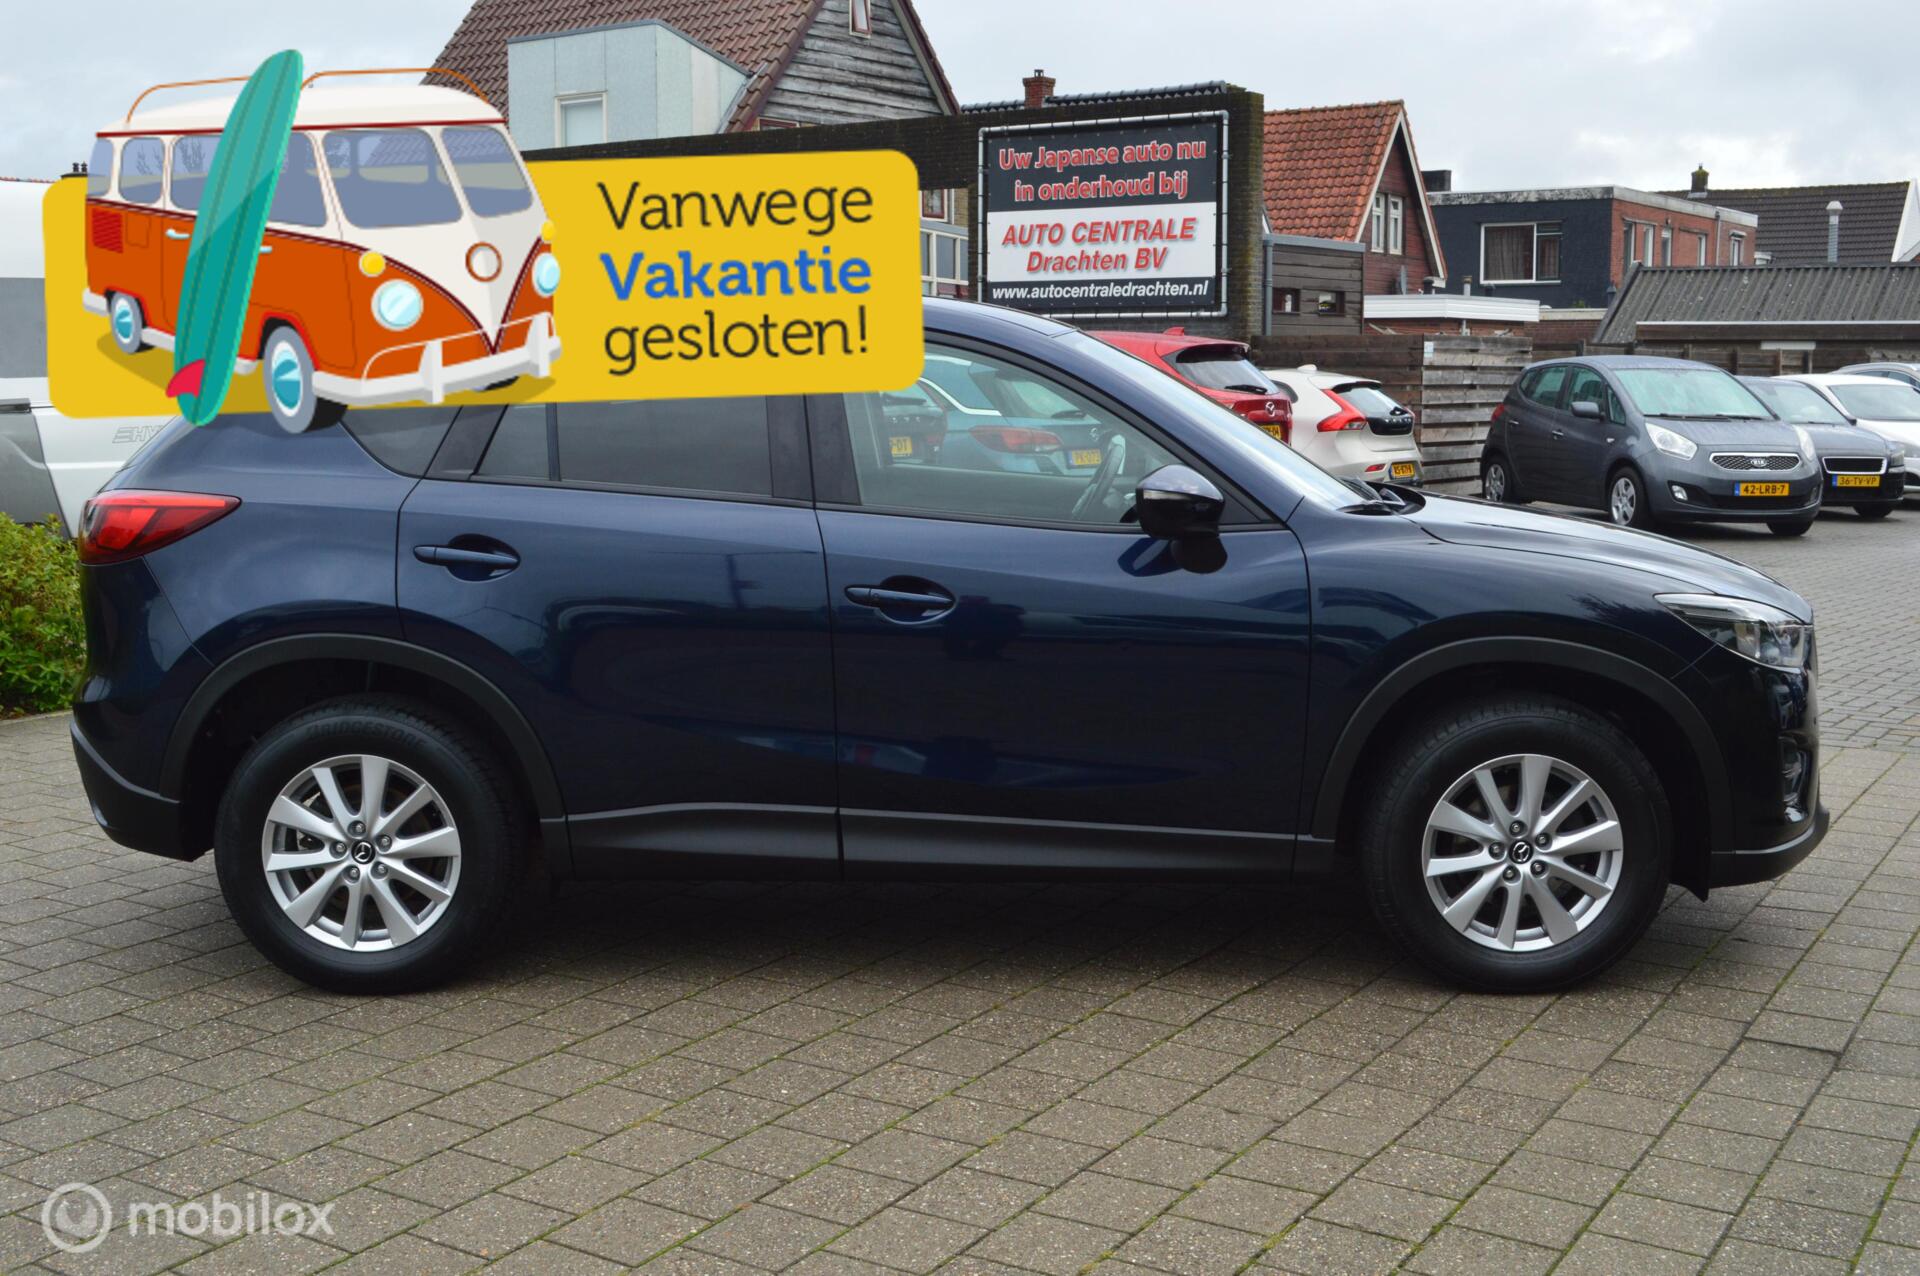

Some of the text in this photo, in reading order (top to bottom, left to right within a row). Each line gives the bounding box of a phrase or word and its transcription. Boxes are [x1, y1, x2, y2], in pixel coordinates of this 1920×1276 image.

[999, 140, 1207, 172] Uw Japanse auto nu
[1014, 170, 1188, 201] in onderhoud bij
[1002, 217, 1197, 245] AUTO CENTRALE
[1026, 246, 1168, 273] Drachten BV
[992, 280, 1209, 300] www.autocentraledrachten.nl
[1743, 484, 1786, 495] 42-LRB-7
[1839, 476, 1877, 486] 36-TV-VP
